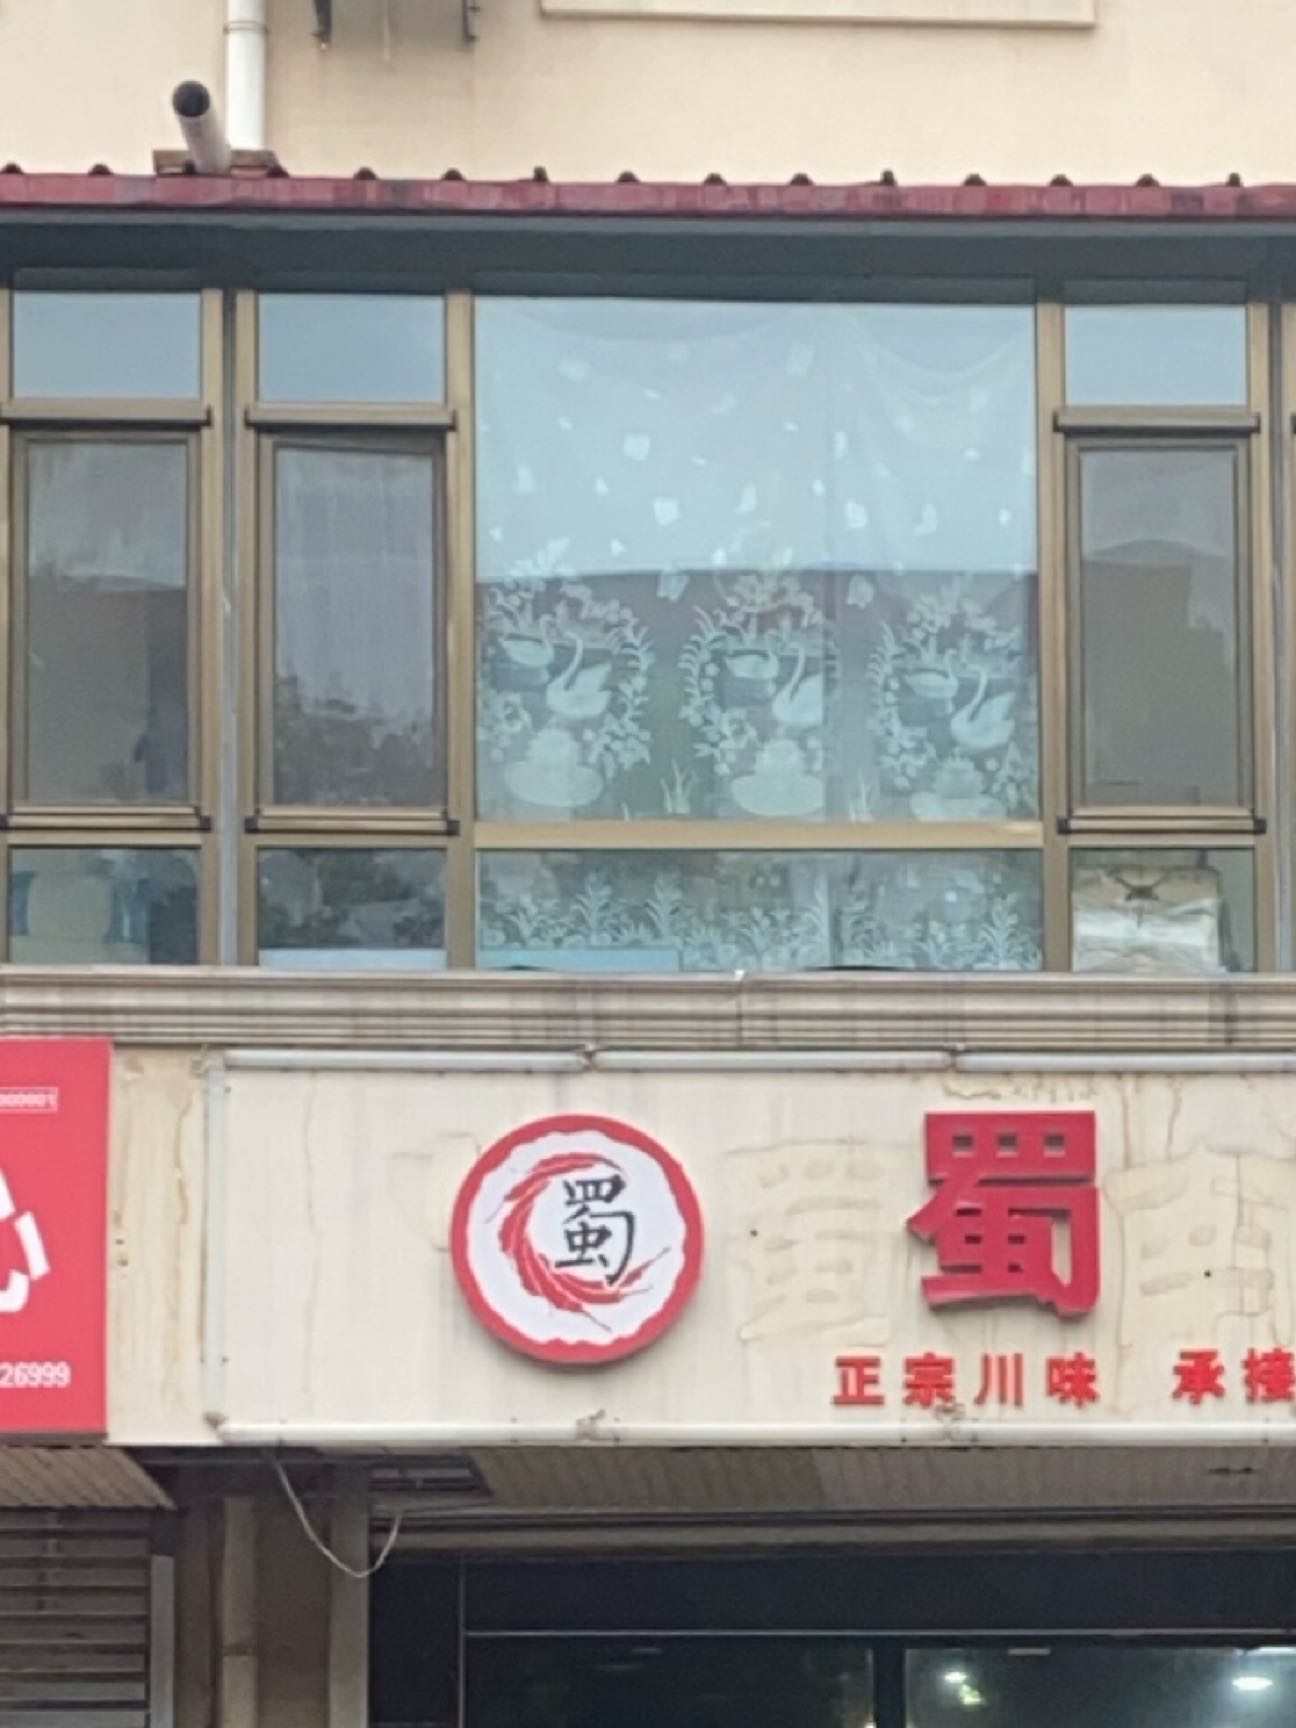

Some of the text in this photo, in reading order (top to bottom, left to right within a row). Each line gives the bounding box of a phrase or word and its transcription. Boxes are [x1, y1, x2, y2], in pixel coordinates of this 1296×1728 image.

[556, 1173, 635, 1287] 蜀
[833, 1351, 1099, 1408] 正宗川味
